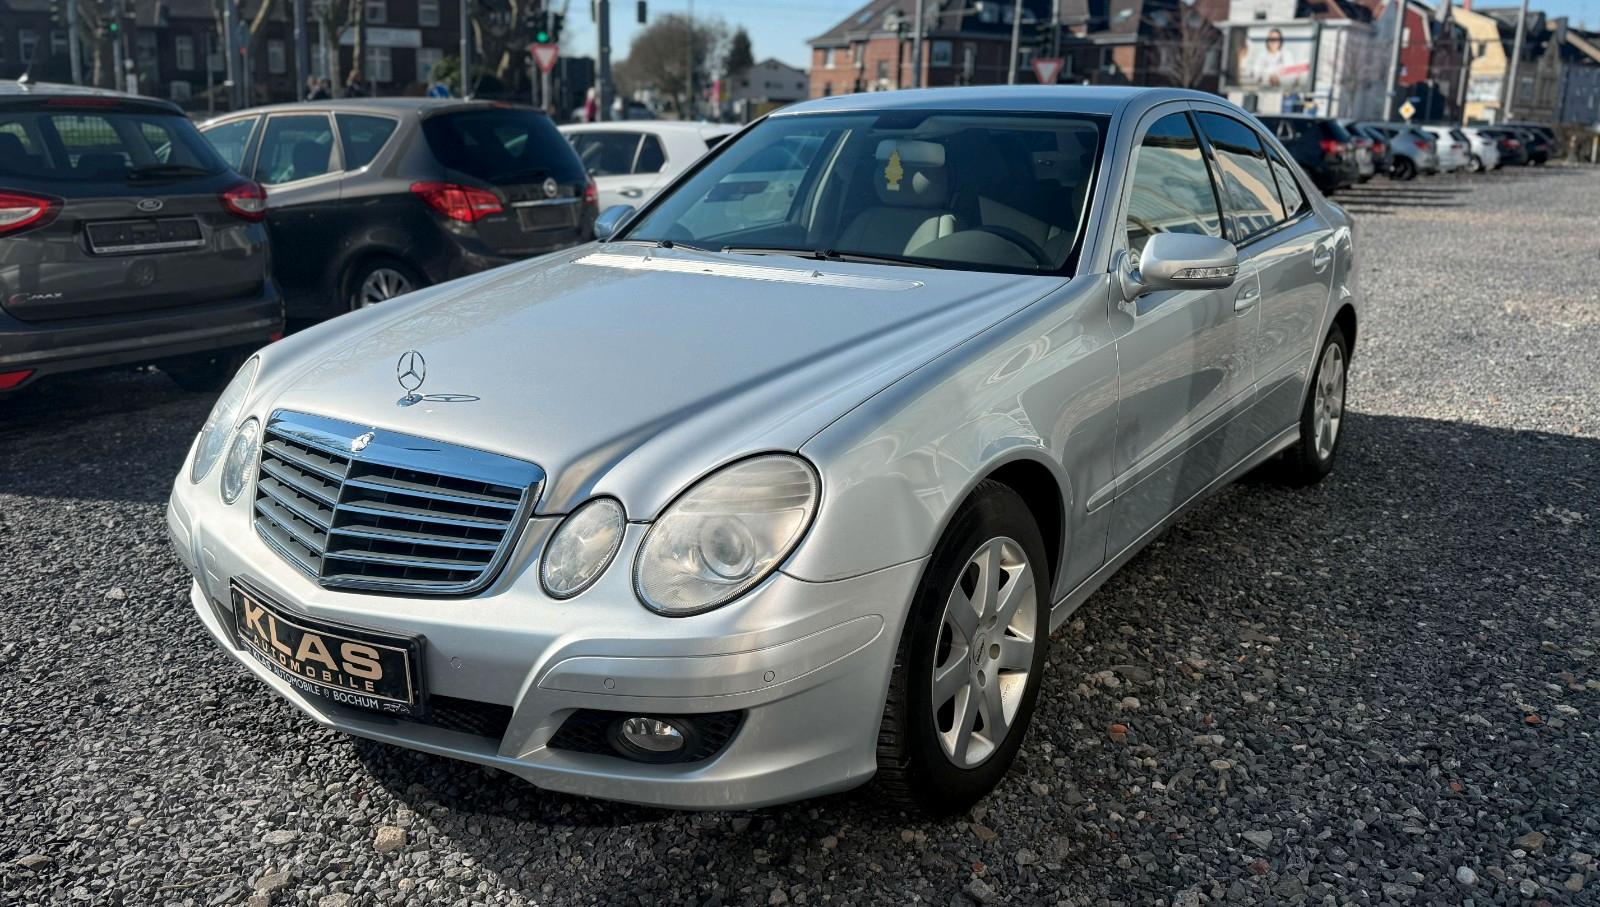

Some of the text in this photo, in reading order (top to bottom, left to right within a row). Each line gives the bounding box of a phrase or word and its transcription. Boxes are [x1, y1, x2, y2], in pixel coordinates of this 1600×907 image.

[243, 597, 383, 681] KLAS
[253, 634, 375, 692] AUTOMOBILE
[252, 649, 379, 709] KLAS AUTOMOBILE BOCHUM
